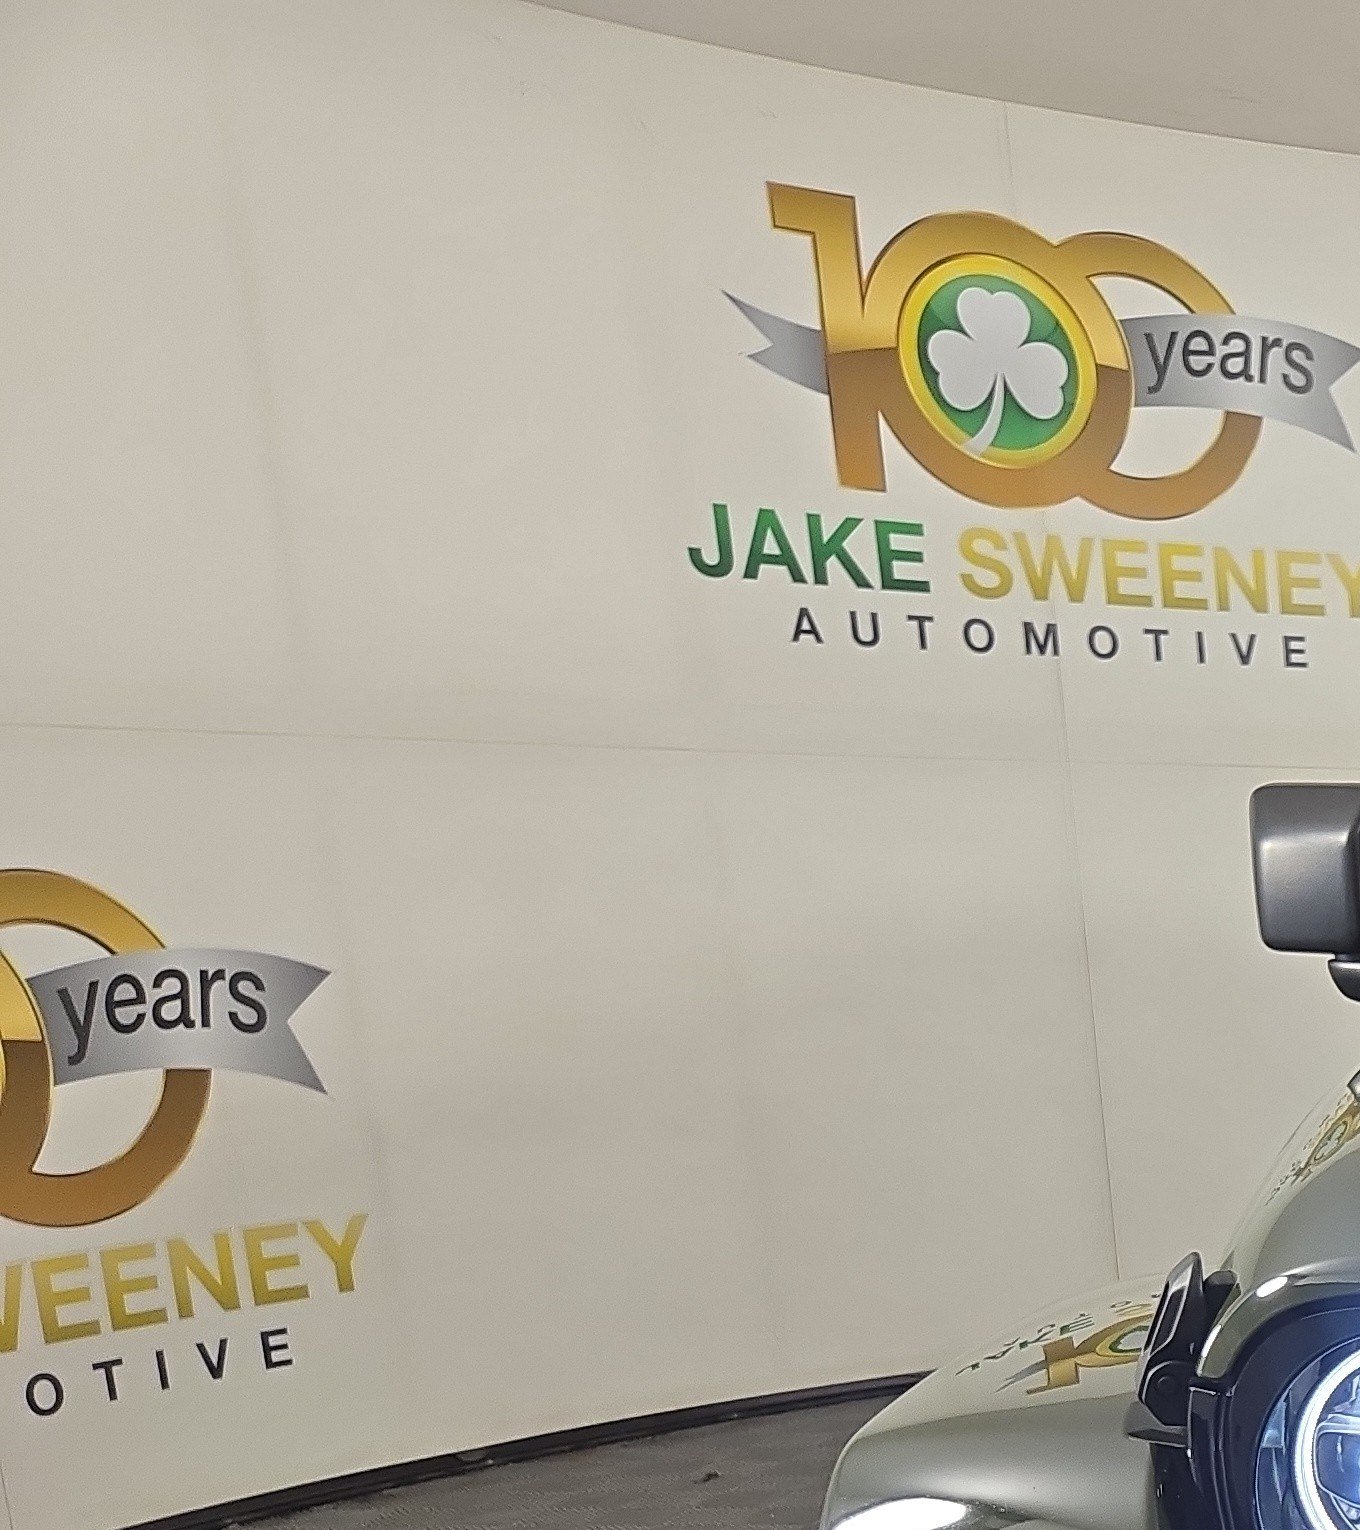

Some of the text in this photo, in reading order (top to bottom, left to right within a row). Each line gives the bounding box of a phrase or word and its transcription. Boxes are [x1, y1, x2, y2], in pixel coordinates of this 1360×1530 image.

[1143, 329, 1315, 397] years
[687, 503, 930, 592] JAKE
[792, 607, 1309, 669] AUTOMOTIVE
[56, 964, 268, 1067] years
